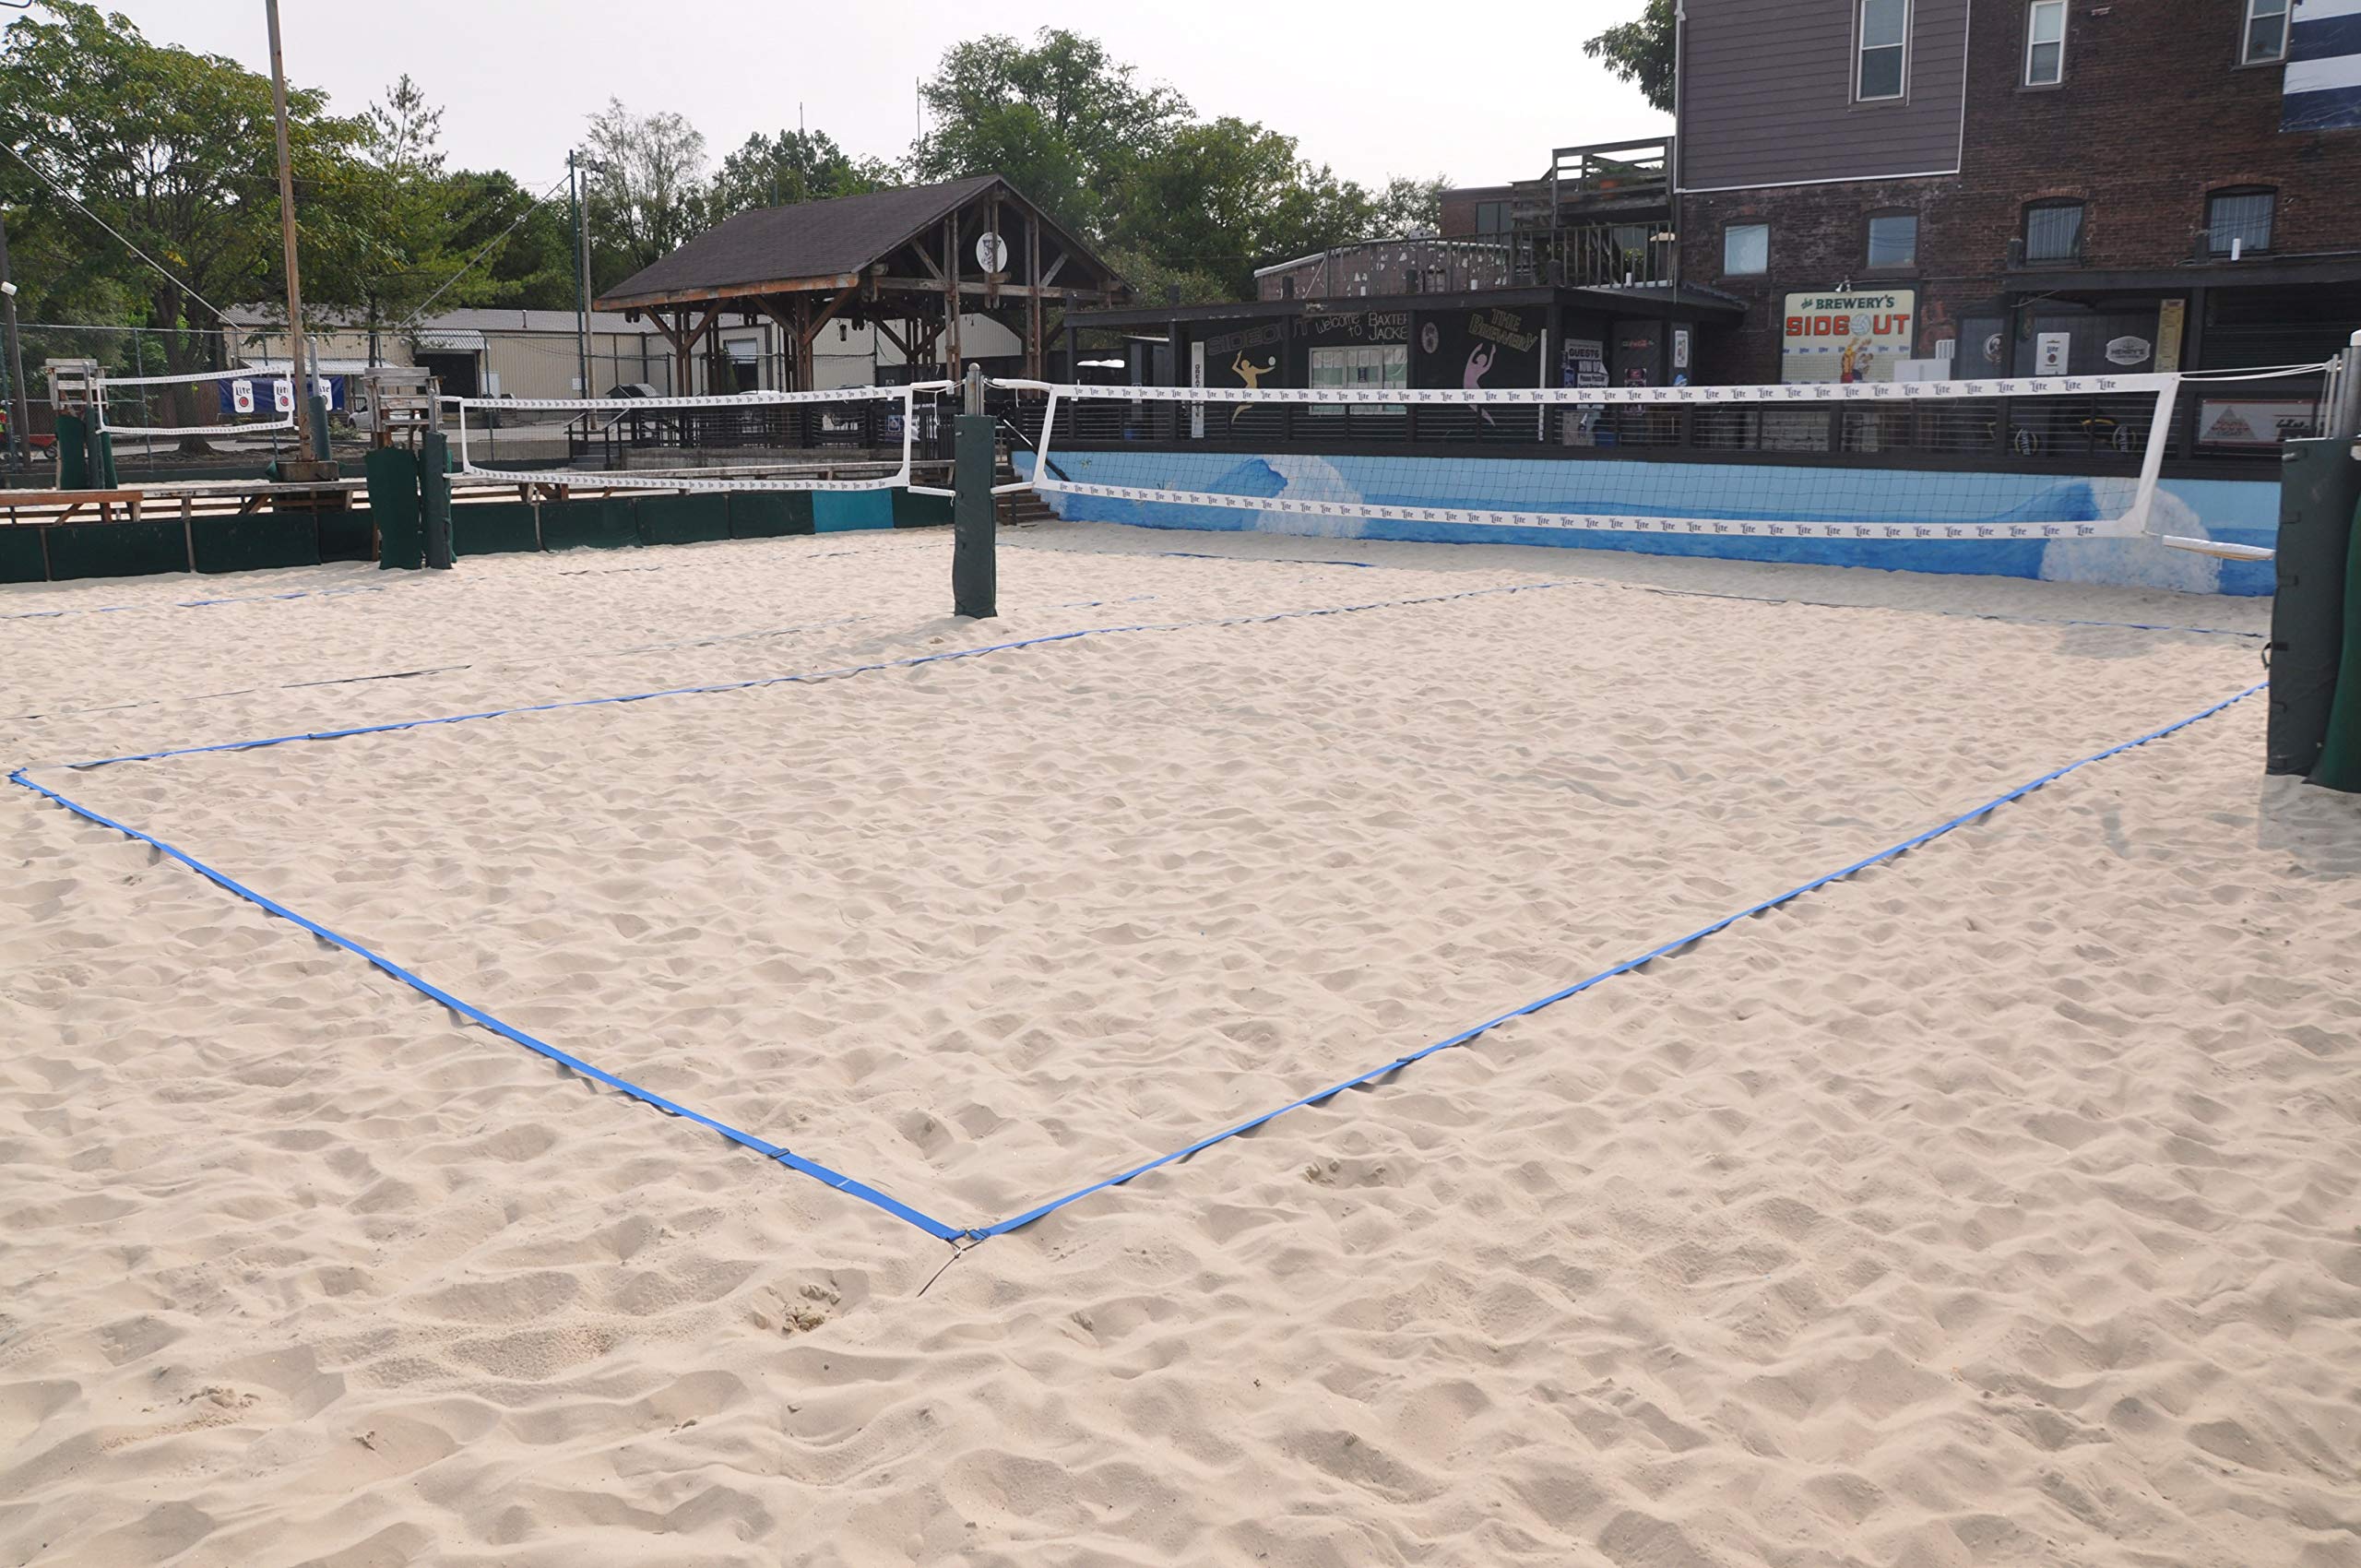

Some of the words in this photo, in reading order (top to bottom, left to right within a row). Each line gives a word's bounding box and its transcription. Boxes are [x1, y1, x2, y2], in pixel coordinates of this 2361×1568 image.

[1816, 294, 1895, 310] BREWERY'S
[235, 386, 251, 396] Lite
[276, 386, 288, 395] Lit
[1356, 391, 1370, 400] Lite
[1376, 390, 1390, 400] Lite
[1396, 390, 1410, 401] Lite
[1418, 391, 1431, 401] Lite
[1440, 391, 1453, 401] Lite
[1461, 390, 1475, 401] Lite
[1484, 390, 1498, 401] Lite
[1506, 390, 1521, 401] Lite
[1529, 390, 1544, 401] Lite
[1552, 390, 1568, 401] Lite
[1577, 389, 1592, 400] Lite
[1601, 389, 1617, 400] Lite
[1626, 389, 1642, 400] Lite
[1651, 389, 1667, 400] Lite
[1677, 388, 1693, 400] Lite
[1703, 387, 1720, 399] Lite
[1729, 387, 1746, 399] Lite
[1756, 386, 1774, 398] Lite
[1785, 386, 1802, 398] Lite
[1813, 386, 1831, 398] Lite
[1842, 385, 1859, 397] Lite
[1871, 384, 1889, 396] Lite
[1902, 383, 1919, 395] Lite
[1932, 383, 1951, 394] Lite
[1964, 382, 1983, 393] Lite
[1995, 380, 2015, 392] Lite
[2028, 379, 2047, 391] Lite
[2061, 378, 2082, 390] Lite
[2094, 377, 2117, 389] Lite
[1422, 509, 1435, 519] Lite
[1444, 511, 1457, 521] Lite
[1466, 512, 1480, 522] Lite
[1489, 513, 1503, 523] Lite
[1512, 514, 1526, 524] Lite
[1536, 515, 1550, 526] Lite
[1560, 516, 1574, 527] Lite
[1584, 517, 1599, 528] Lite
[1608, 517, 1624, 529] Lite
[1633, 518, 1649, 529] Lite
[1659, 520, 1676, 530] Lite
[1686, 521, 1702, 531] Lite
[1712, 522, 1728, 532] Lite
[1739, 523, 1756, 533] Lite
[1767, 523, 1785, 534] Lite
[1795, 524, 1812, 535] Lite
[1824, 524, 1841, 536] Lite
[1853, 525, 1871, 537] Lite
[1883, 526, 1901, 537] Lite
[1913, 525, 1931, 537] Lite
[1944, 525, 1963, 537] Lite
[1975, 525, 1994, 537] Lite
[2008, 525, 2027, 536] Lite
[2041, 524, 2060, 536] Lite
[2074, 524, 2094, 535] Lite
